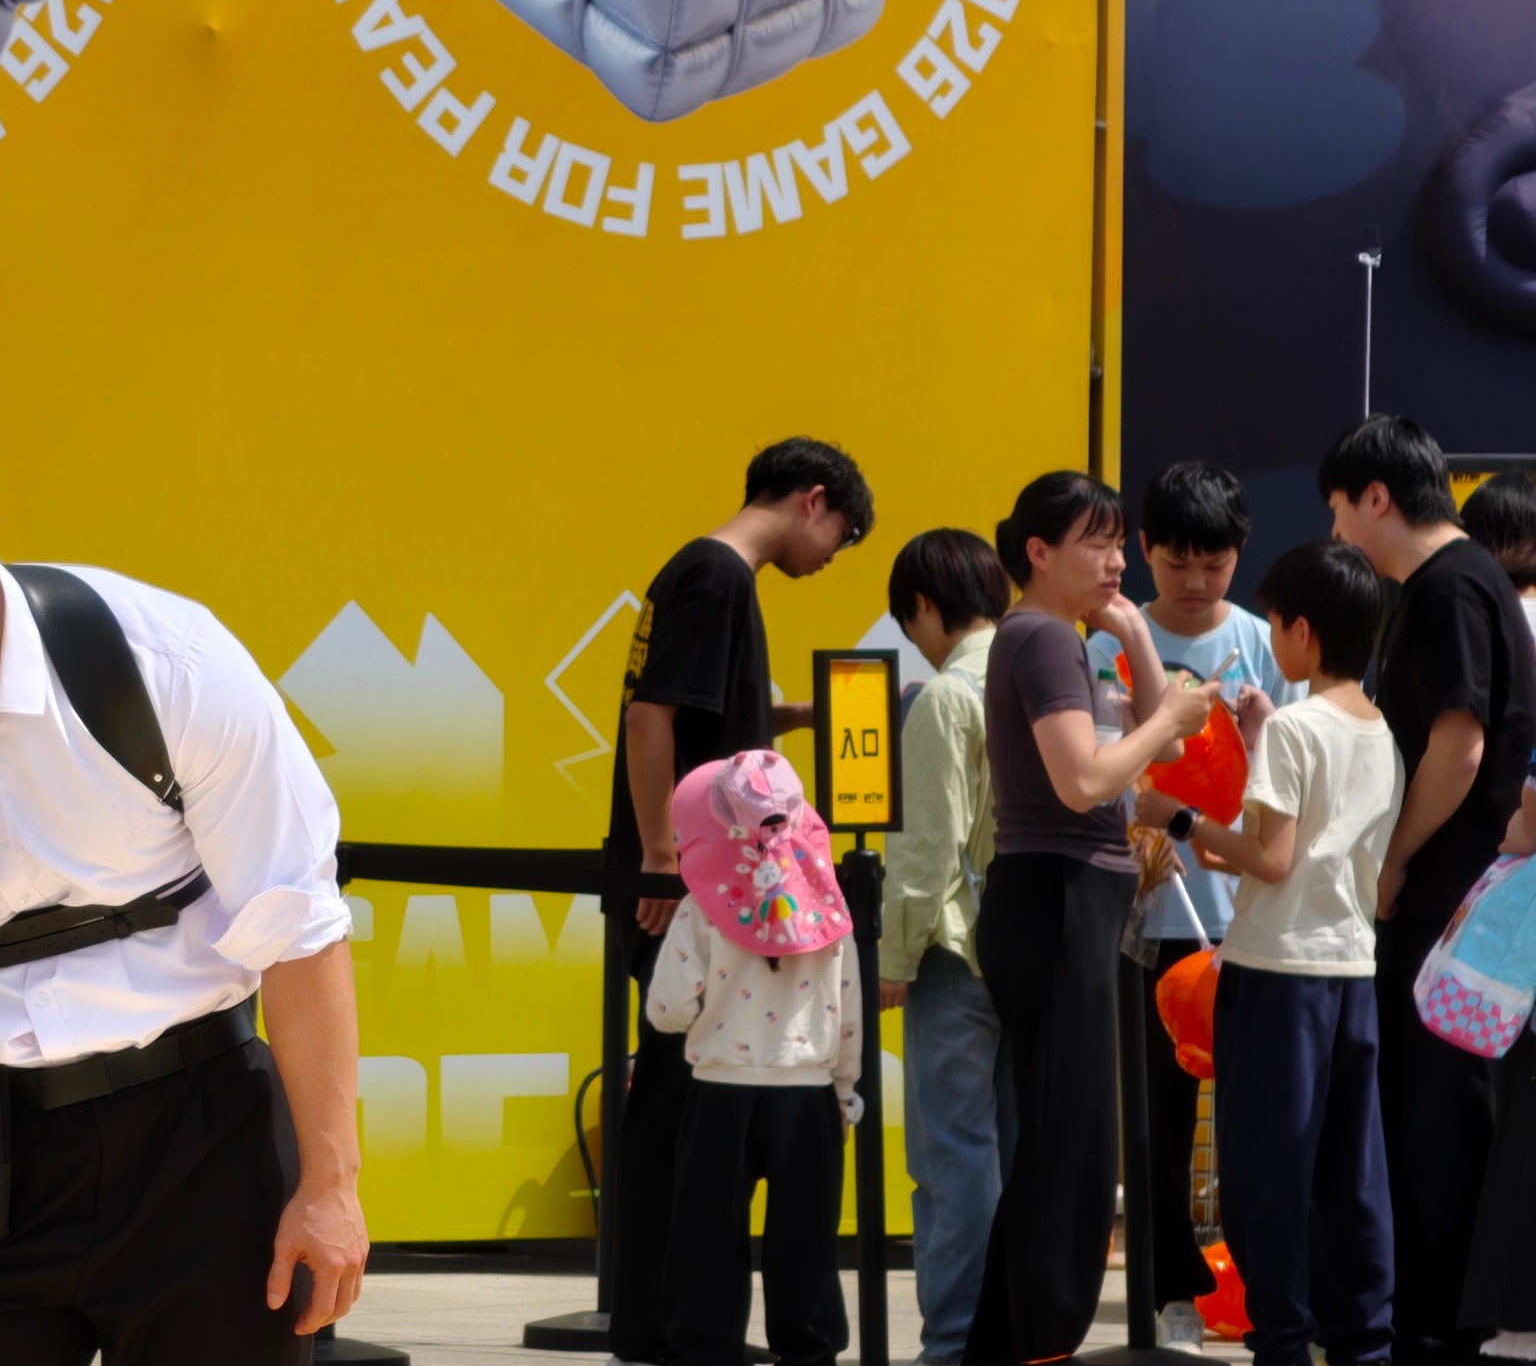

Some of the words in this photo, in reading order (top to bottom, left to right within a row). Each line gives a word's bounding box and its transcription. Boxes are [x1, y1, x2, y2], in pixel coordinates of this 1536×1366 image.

[489, 116, 656, 238] FOR
[678, 90, 913, 242] GAME
[841, 728, 878, 759] 入口
